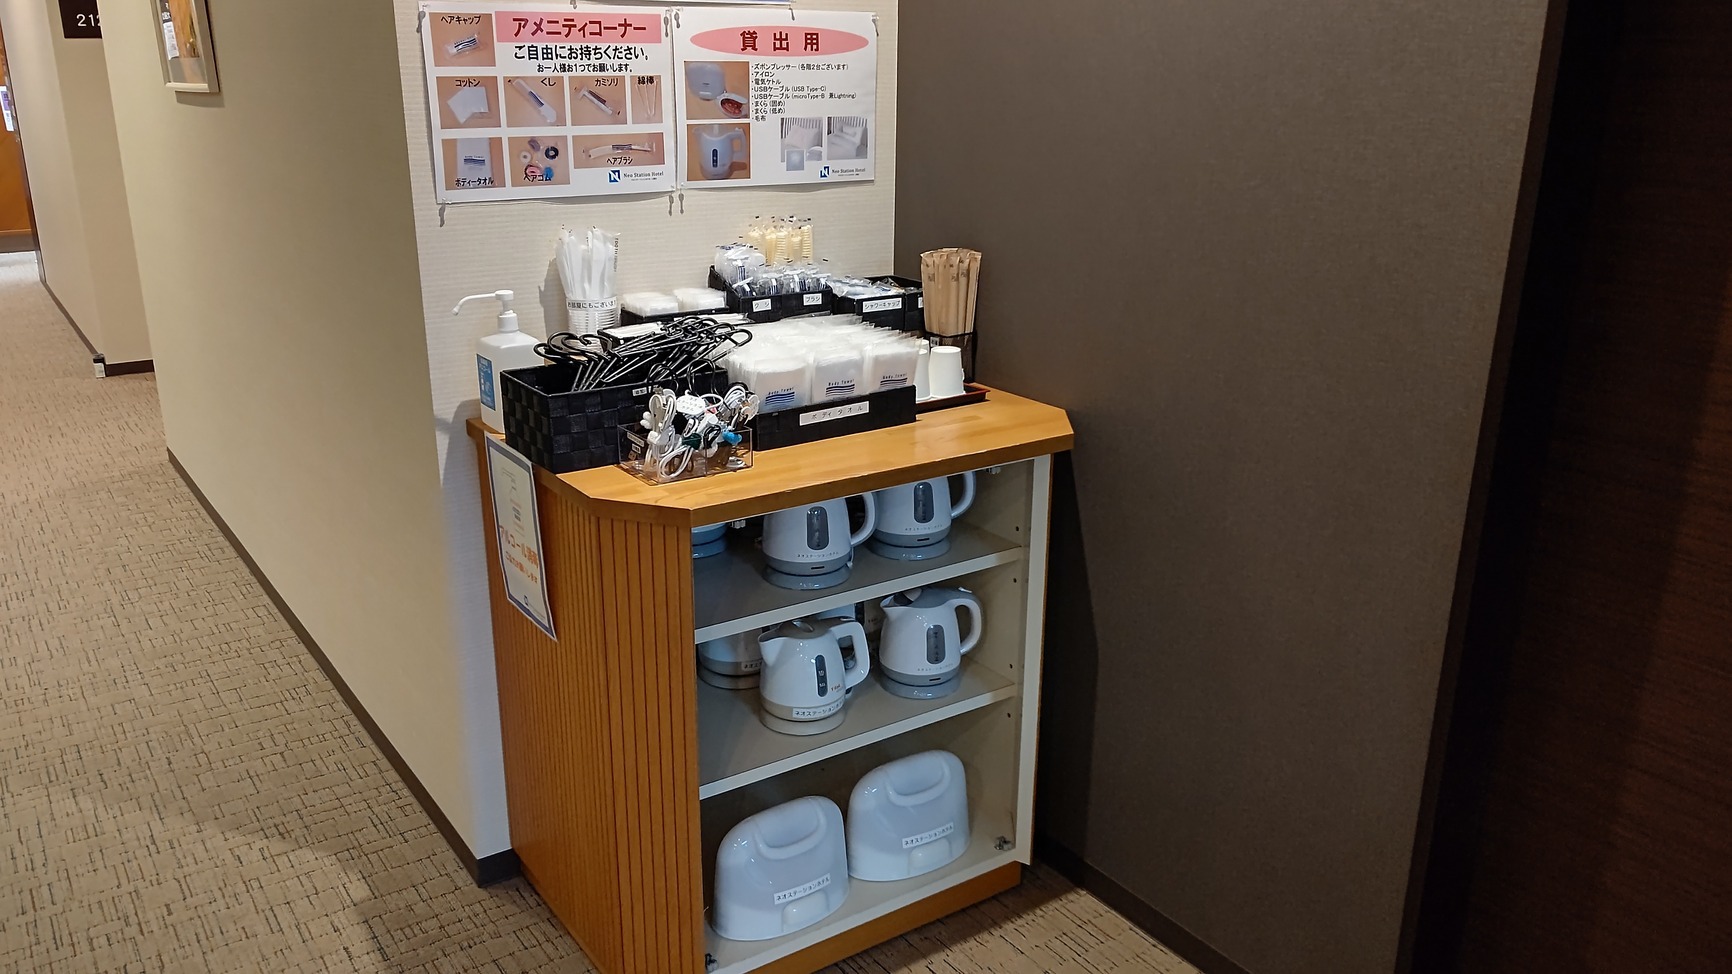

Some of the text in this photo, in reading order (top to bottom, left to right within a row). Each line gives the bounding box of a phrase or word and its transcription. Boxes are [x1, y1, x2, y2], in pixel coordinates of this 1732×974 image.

[76, 13, 101, 27] 21
[441, 15, 482, 25] ヘアキャップ
[512, 17, 647, 39] アメニティコーナー
[514, 44, 649, 61] ご自由にお持ちください。
[537, 63, 633, 73] お一人様お1つでお願いします。
[455, 78, 481, 87] コットン
[541, 78, 556, 87] くし
[595, 78, 619, 87] カミソリ
[637, 76, 655, 86] 綿棒
[606, 157, 633, 166] ヘアブラシ
[455, 177, 495, 187] ボディータオル
[864, 299, 902, 310] シャワーキャップ
[744, 660, 763, 669] ネオス
[904, 824, 954, 847] ネオステーションホテル
[776, 876, 831, 902] ネオステーションホテル
